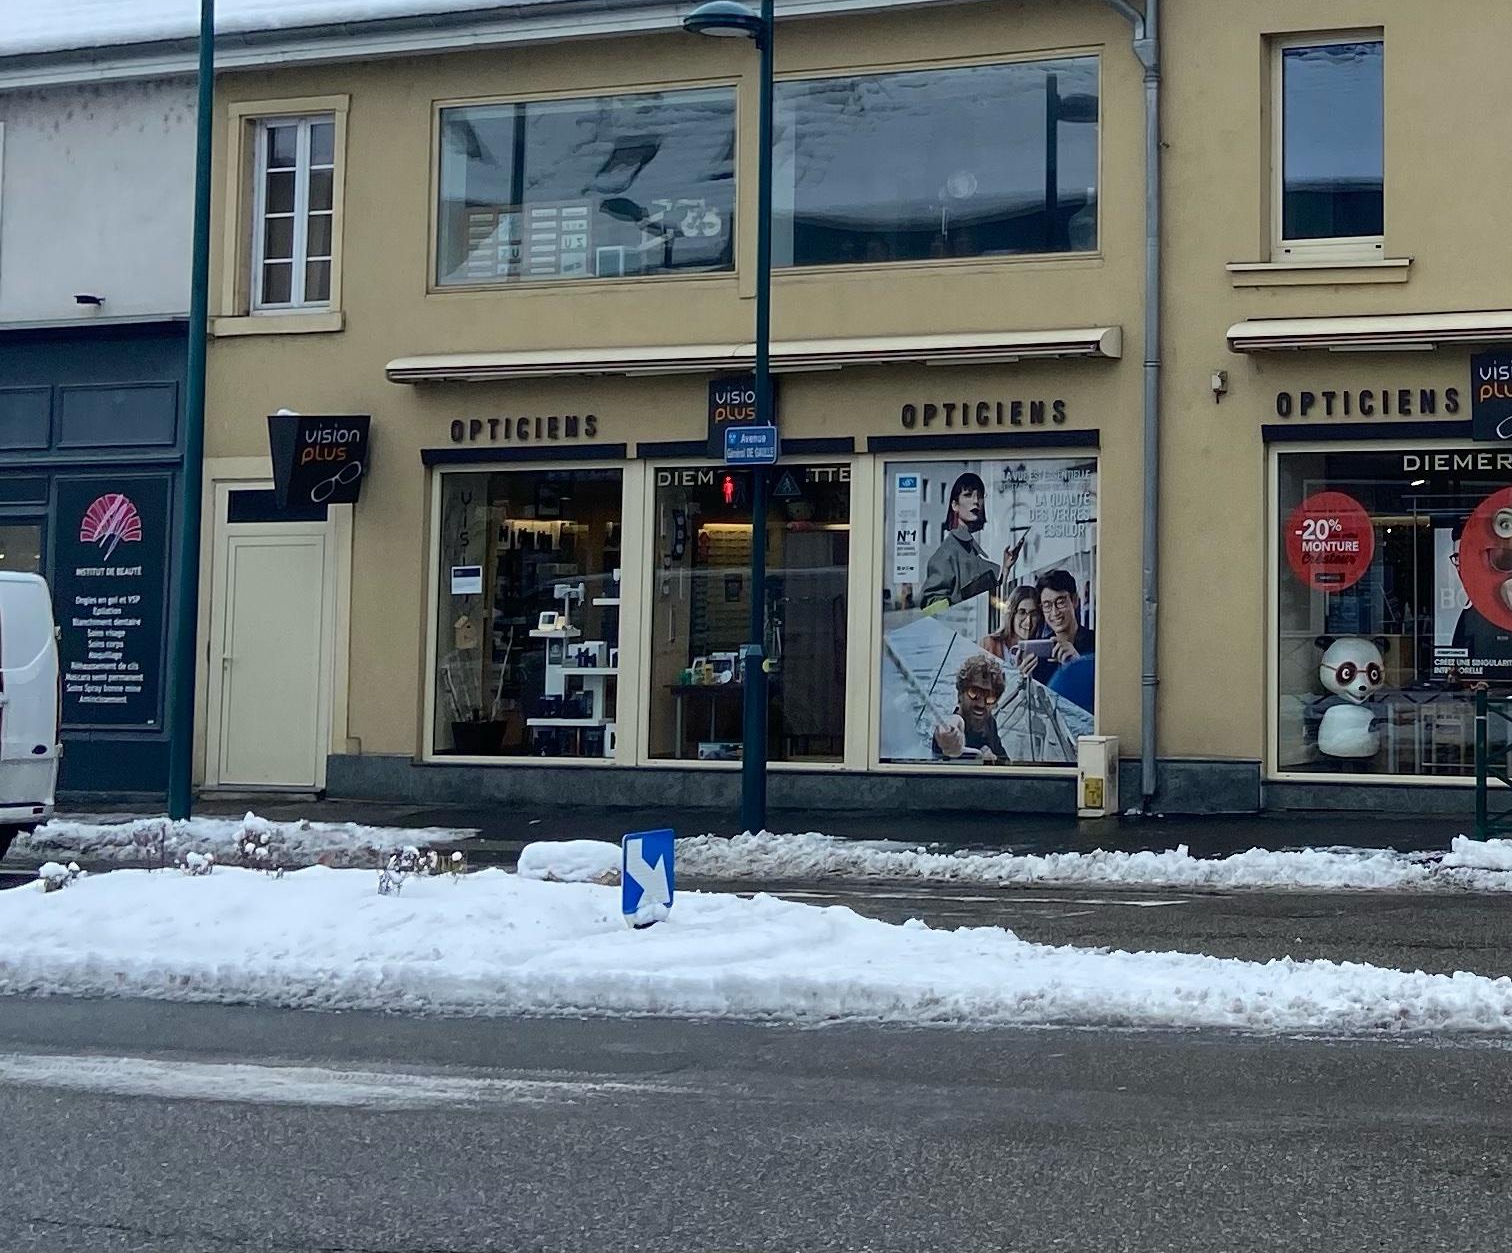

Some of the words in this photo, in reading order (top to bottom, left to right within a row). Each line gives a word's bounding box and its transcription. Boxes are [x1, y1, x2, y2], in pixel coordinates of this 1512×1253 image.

[715, 386, 756, 405] visio
[1276, 387, 1460, 417] OPTICIENS
[714, 406, 756, 424] plus
[901, 399, 1067, 429] OPTICIENS
[305, 423, 360, 444] vision
[450, 414, 598, 443] OPTICIENS
[300, 445, 348, 466] plus
[1403, 452, 1512, 471] DIEMER
[1295, 518, 1342, 540] -20%
[1301, 541, 1360, 552] MONTURE
